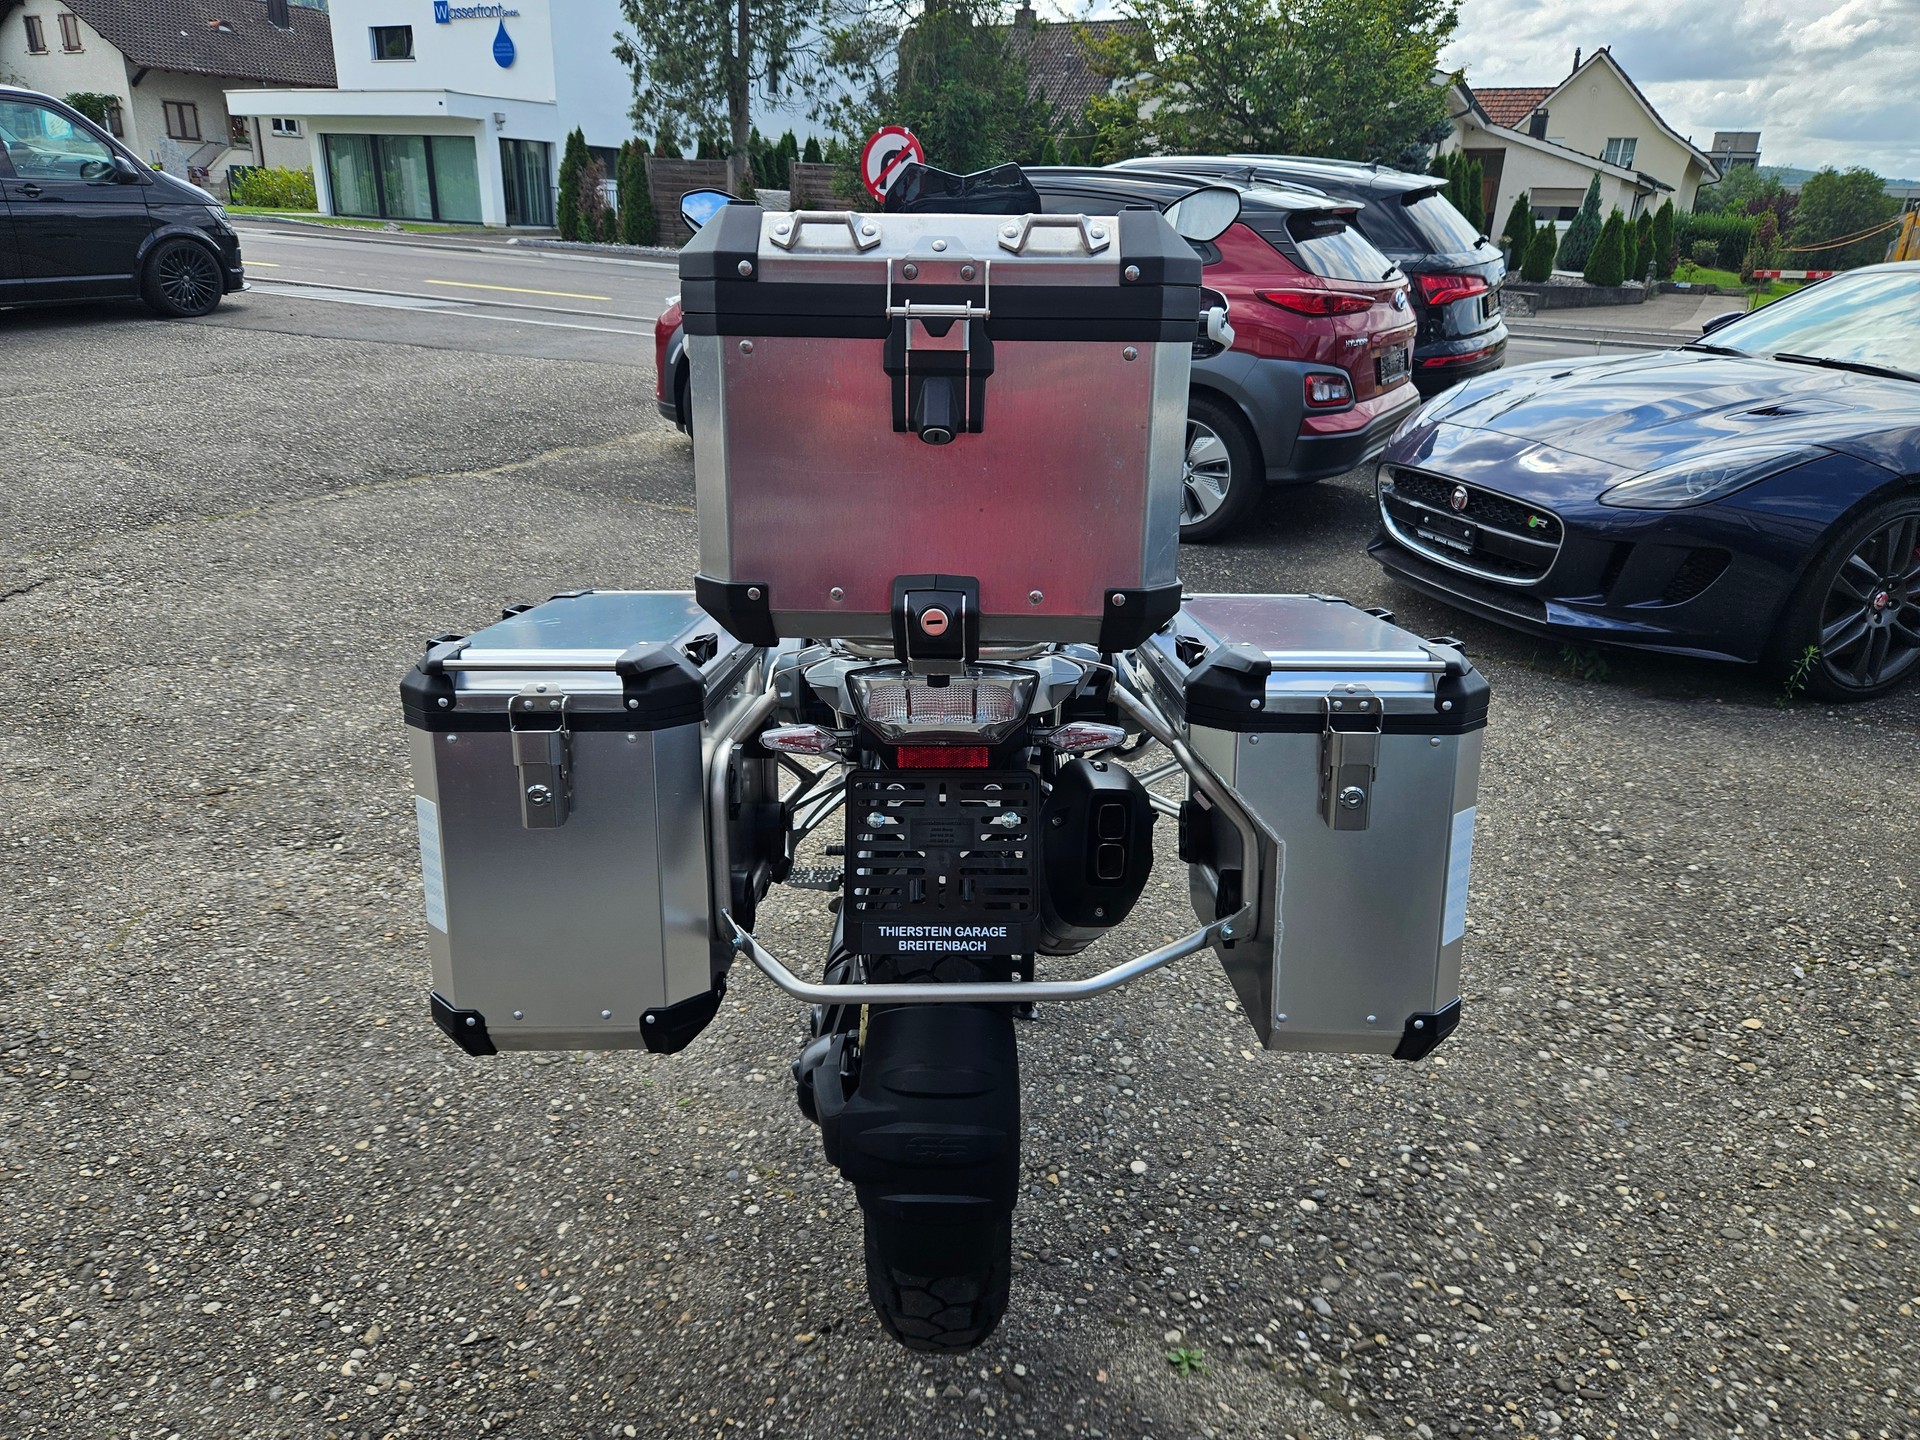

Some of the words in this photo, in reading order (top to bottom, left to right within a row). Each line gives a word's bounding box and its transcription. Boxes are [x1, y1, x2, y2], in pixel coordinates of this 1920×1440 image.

[434, 2, 502, 20] Wasserfront
[878, 926, 952, 937] THIERSTEIN
[954, 926, 1007, 937] GARAGE
[898, 940, 987, 951] BREITENBACH
